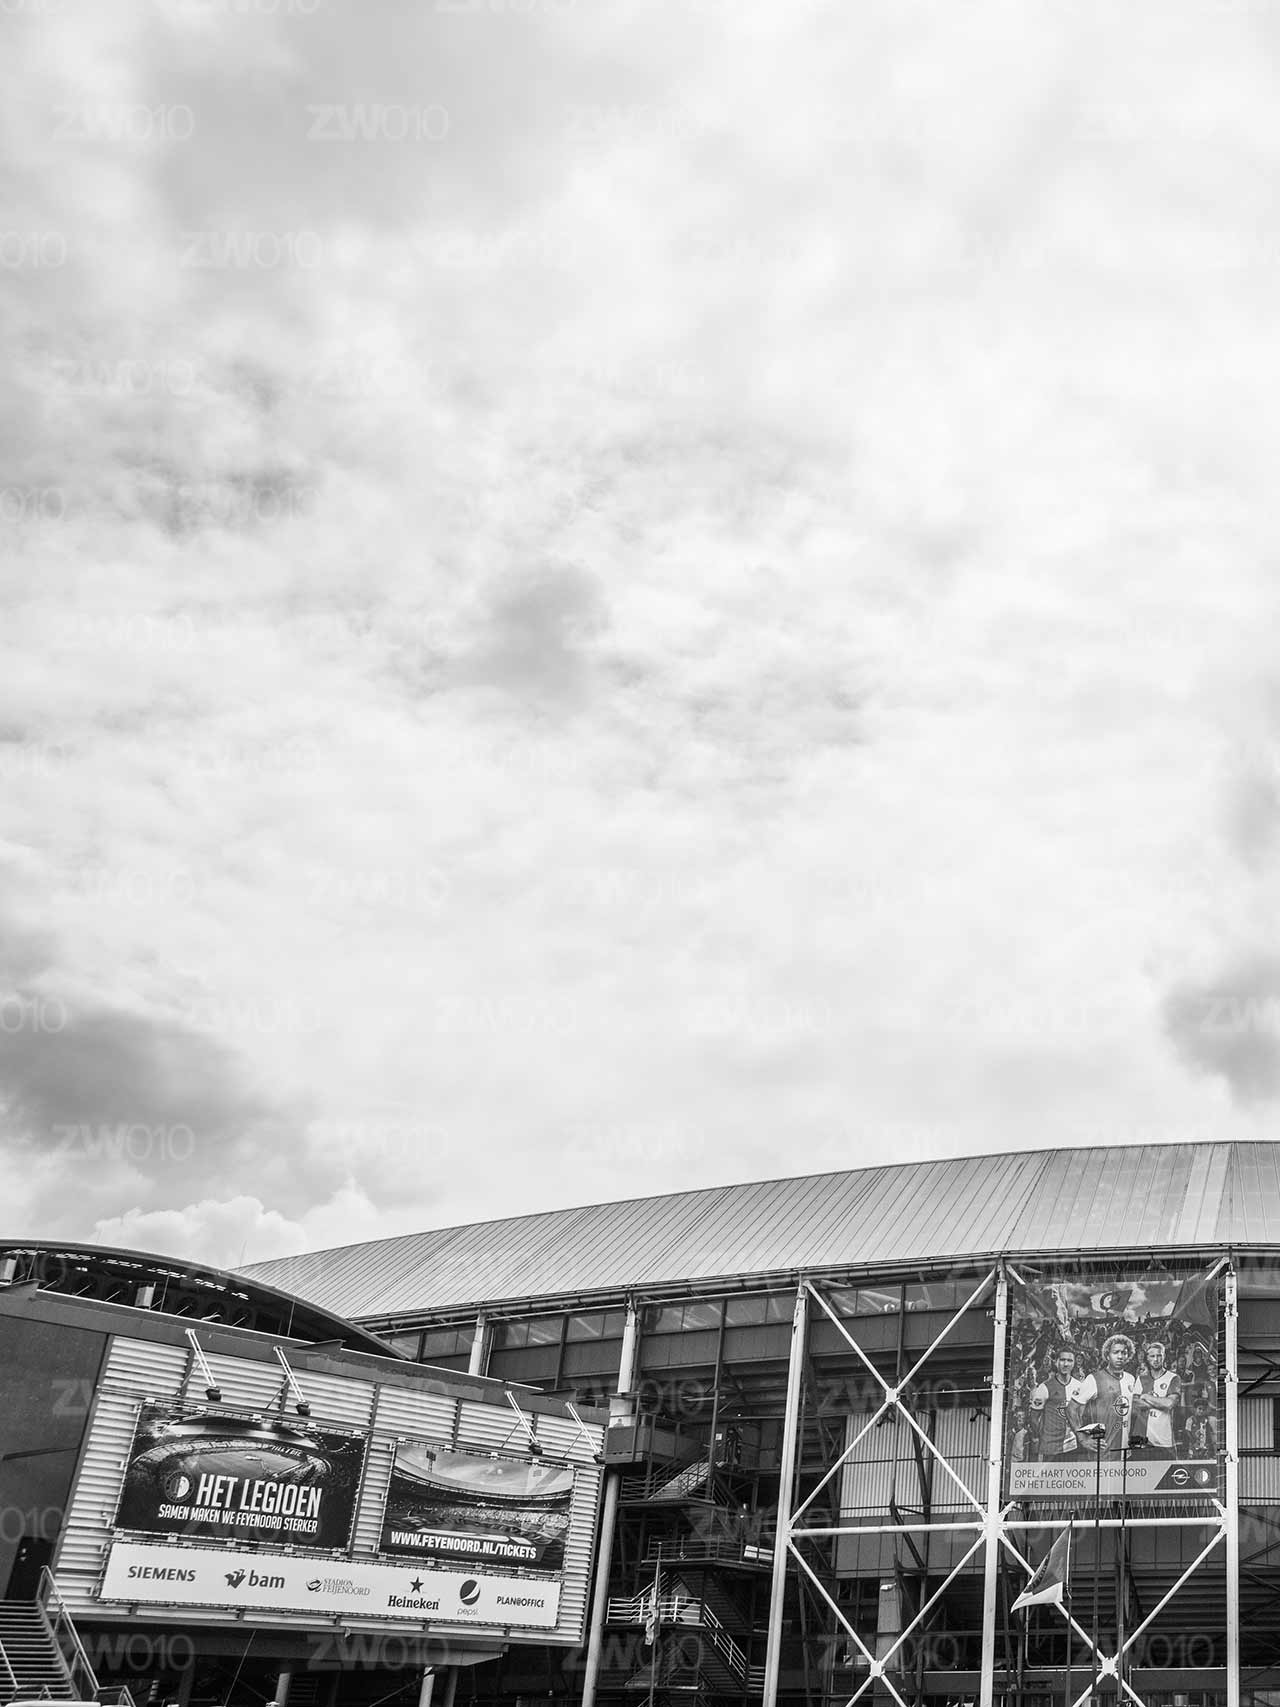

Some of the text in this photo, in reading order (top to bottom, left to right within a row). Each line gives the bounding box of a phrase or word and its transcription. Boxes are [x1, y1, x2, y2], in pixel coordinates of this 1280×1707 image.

[1041, 1468, 1065, 1478] HART
[1066, 1468, 1092, 1478] VOOR
[1014, 1480, 1026, 1489] EN
[1027, 1480, 1045, 1489] HET
[196, 1473, 239, 1509] HET
[240, 1479, 323, 1518] LEGIOEN
[158, 1503, 318, 1533] SAMEN MAKEN WE FEYENOORD STERKER
[391, 1531, 537, 1560] WWW.FEYENOORD.NL/TICKETS
[127, 1565, 197, 1582] SIEMENS
[249, 1569, 285, 1589] bam
[387, 1594, 439, 1611] Heineken
[457, 1607, 479, 1617] pepsi
